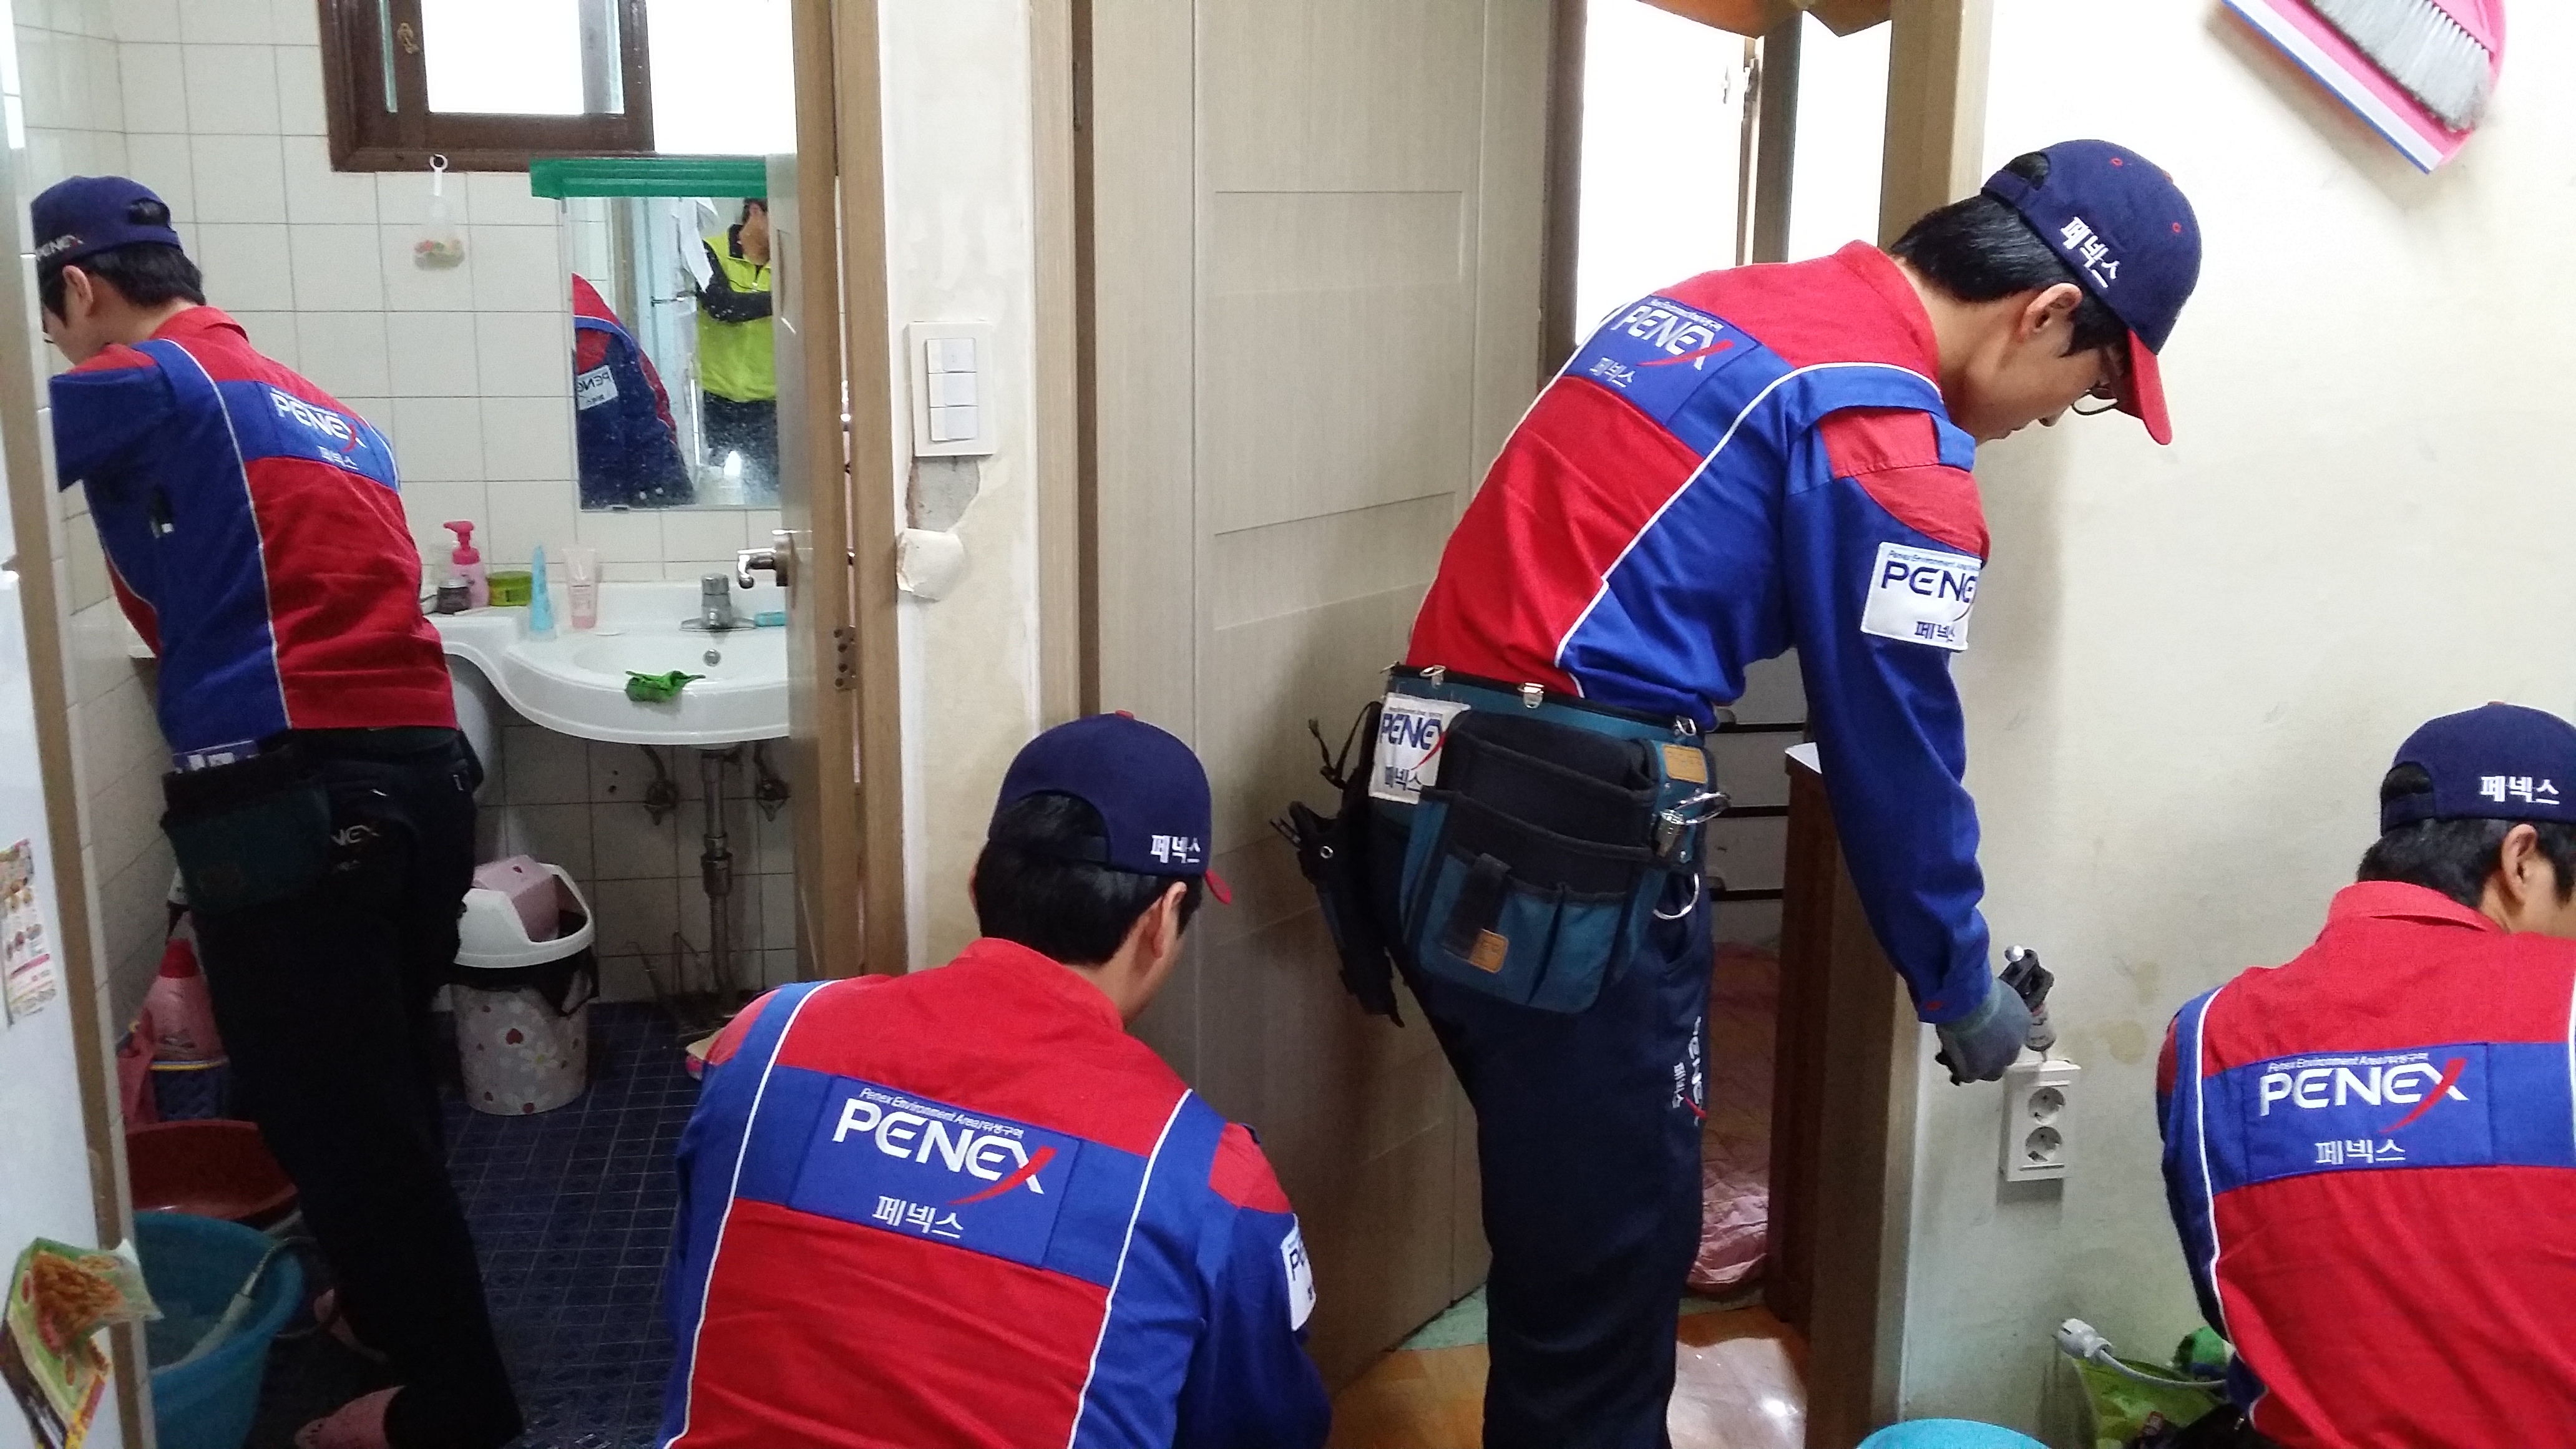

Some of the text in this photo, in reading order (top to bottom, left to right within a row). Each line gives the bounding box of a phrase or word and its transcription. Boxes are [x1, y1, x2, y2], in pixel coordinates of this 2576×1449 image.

[2061, 216, 2120, 288] 페넥스
[1610, 305, 1734, 371] PENEX
[270, 392, 367, 453] PENEX
[1881, 560, 1978, 608] PENE
[2480, 776, 2560, 805] 페넥스
[1150, 834, 1201, 864] 페넥스
[2260, 1057, 2469, 1133] PENEX
[832, 1098, 1057, 1205] PENEX
[2315, 1138, 2407, 1165] 페넥스
[872, 1195, 964, 1239] 페넥스
